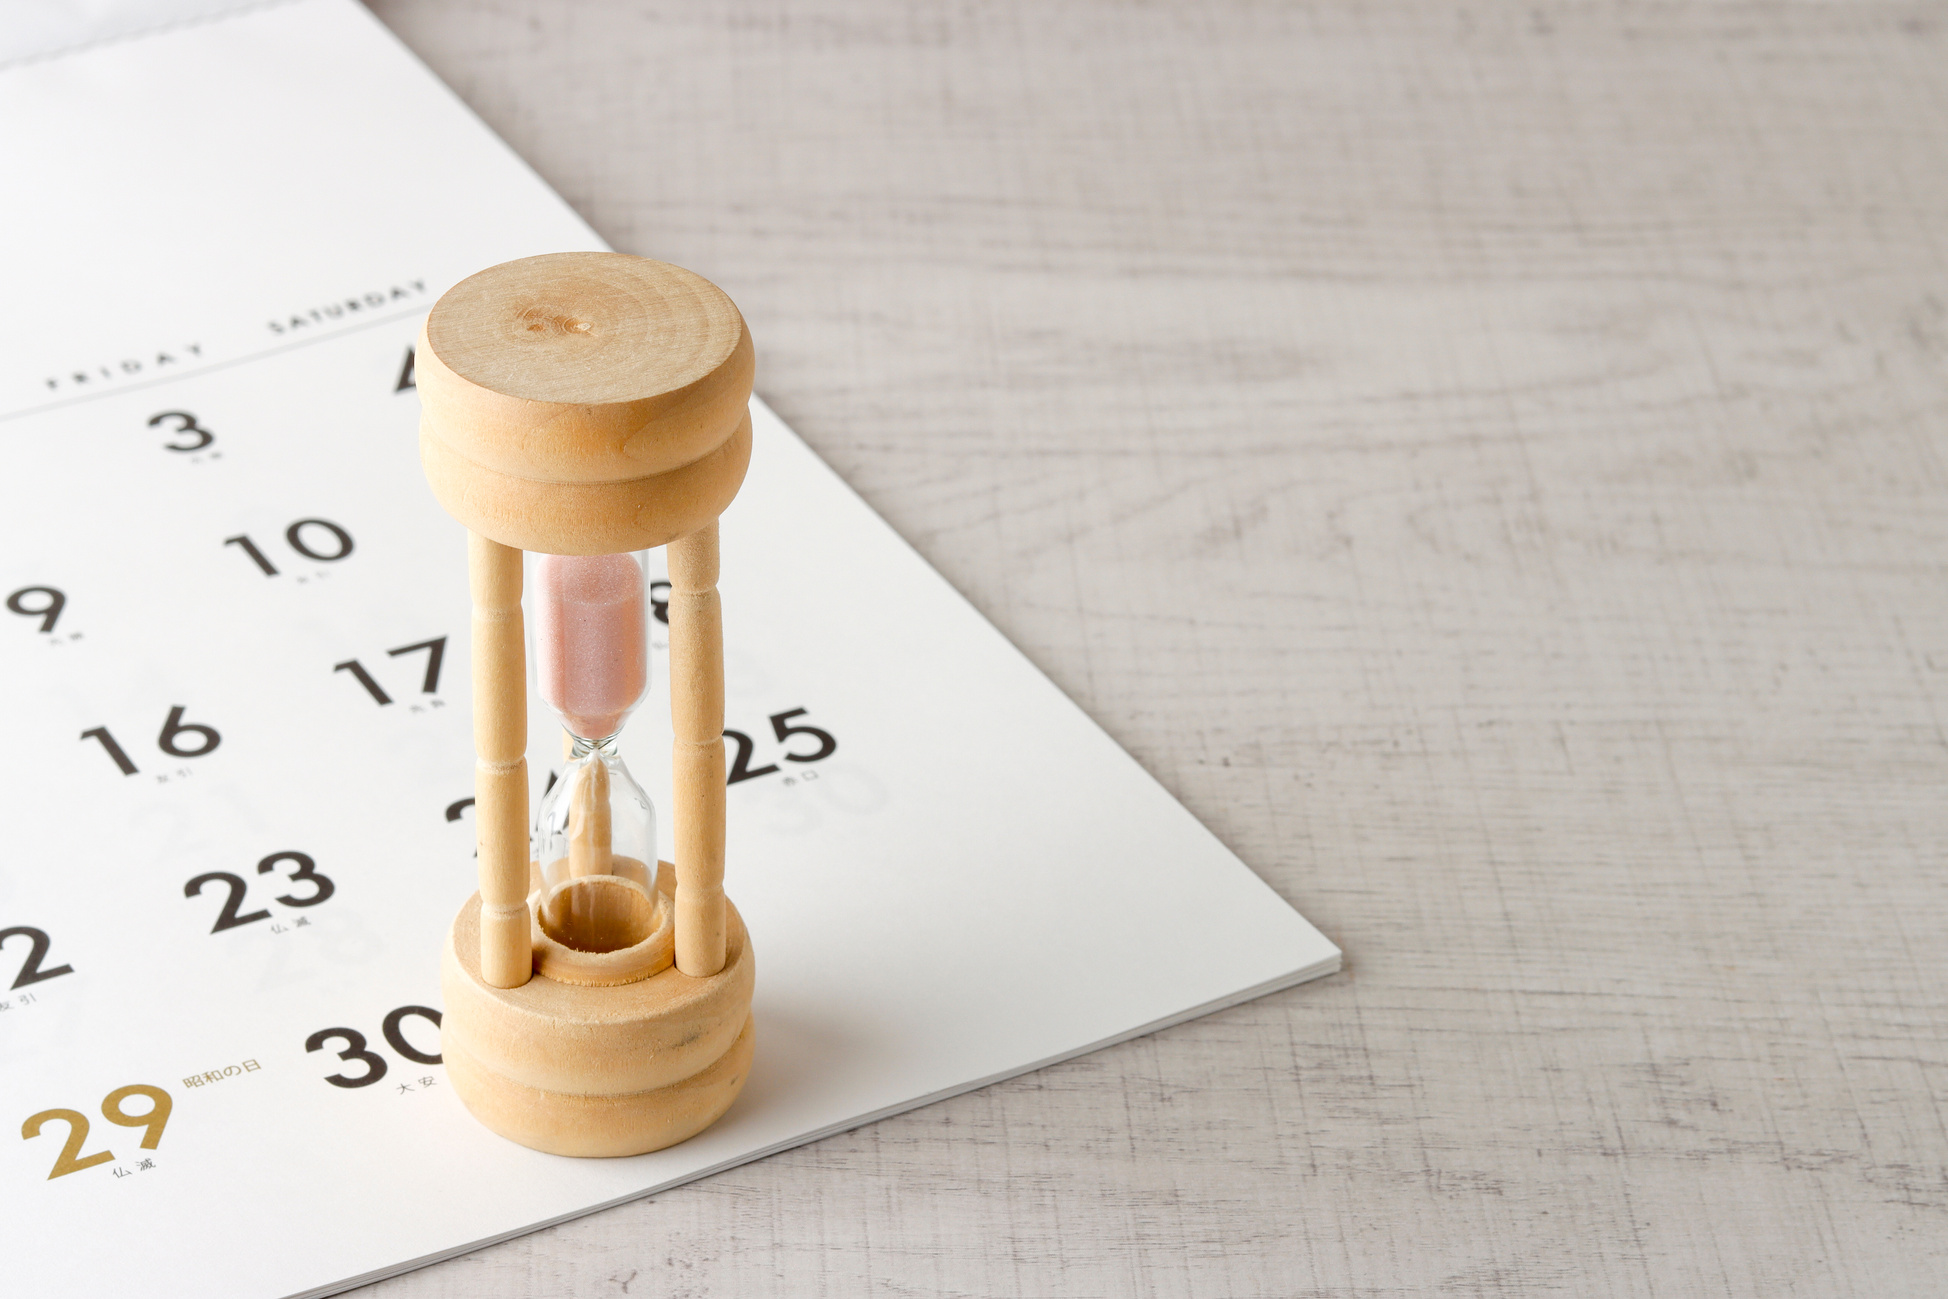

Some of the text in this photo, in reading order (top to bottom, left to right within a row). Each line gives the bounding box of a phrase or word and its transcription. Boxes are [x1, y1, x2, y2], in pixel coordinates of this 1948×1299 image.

[268, 279, 428, 335] SATURDAY
[45, 343, 203, 391] FRIDAY
[147, 411, 216, 454] 3
[224, 518, 355, 578] 10
[5, 585, 67, 634] 9
[333, 635, 448, 707] 17
[80, 705, 222, 778] 16
[723, 706, 838, 786] 25
[183, 850, 336, 936] 23
[0, 925, 75, 992] 2
[181, 1058, 263, 1090] 昭和の日
[304, 1004, 442, 1089] 30
[395, 1075, 438, 1096] 大安
[20, 1083, 174, 1181] 29
[111, 1156, 158, 1180] 仏滅
